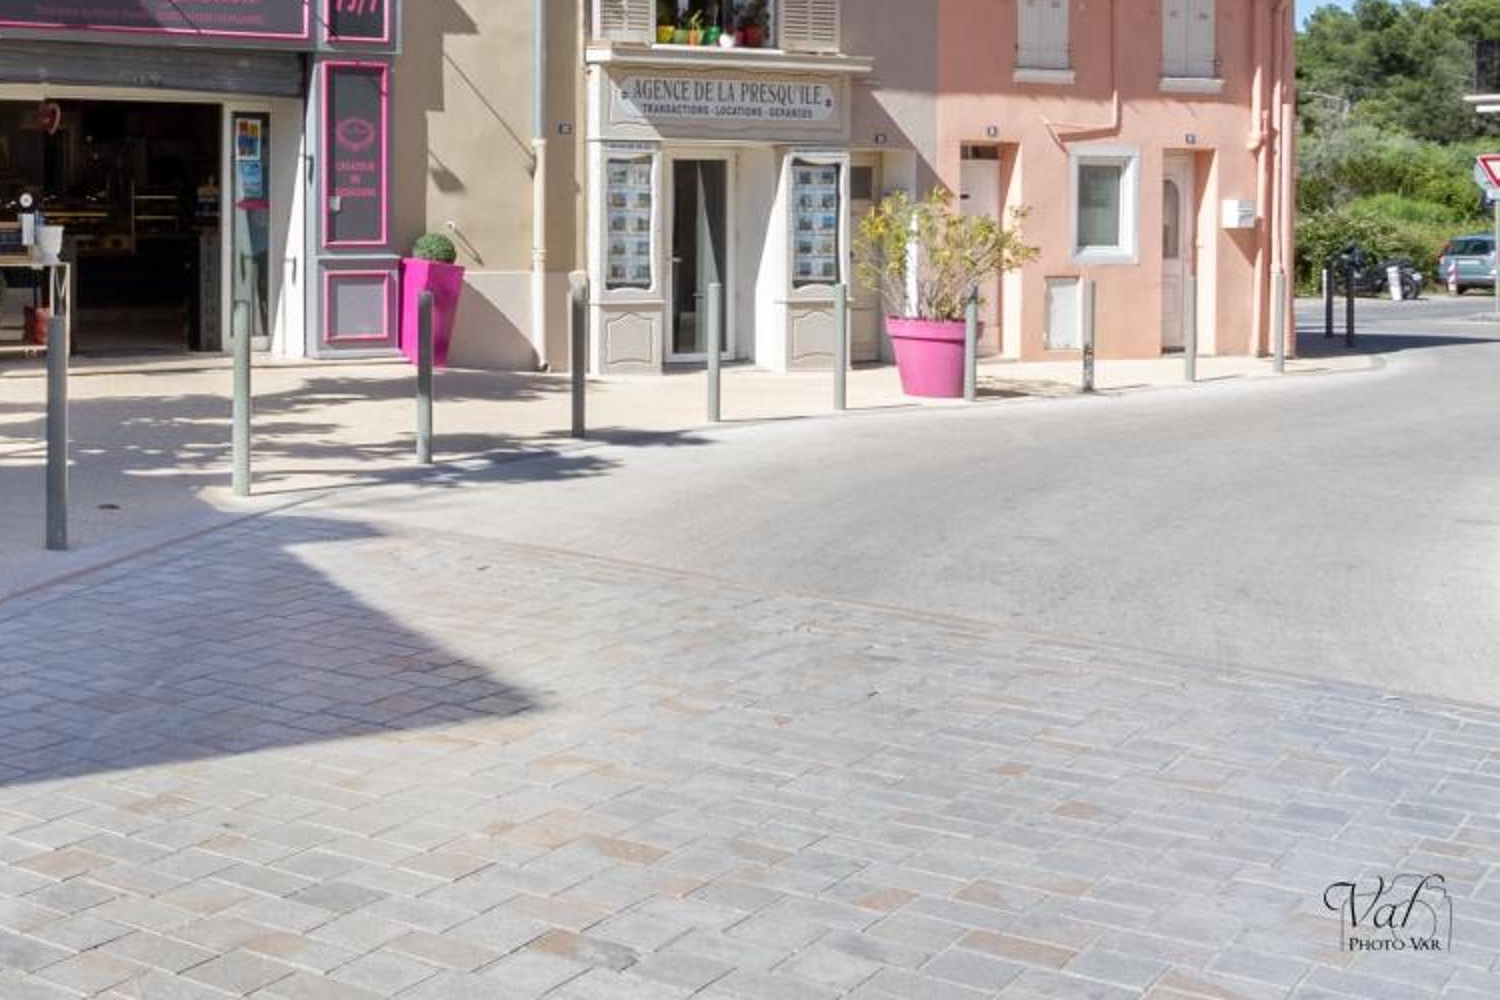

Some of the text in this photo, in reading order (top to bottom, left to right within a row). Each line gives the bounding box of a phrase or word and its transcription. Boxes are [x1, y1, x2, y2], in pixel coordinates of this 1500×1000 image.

[633, 79, 689, 100] AGENCE
[695, 82, 714, 101] DE
[717, 83, 736, 102] LA
